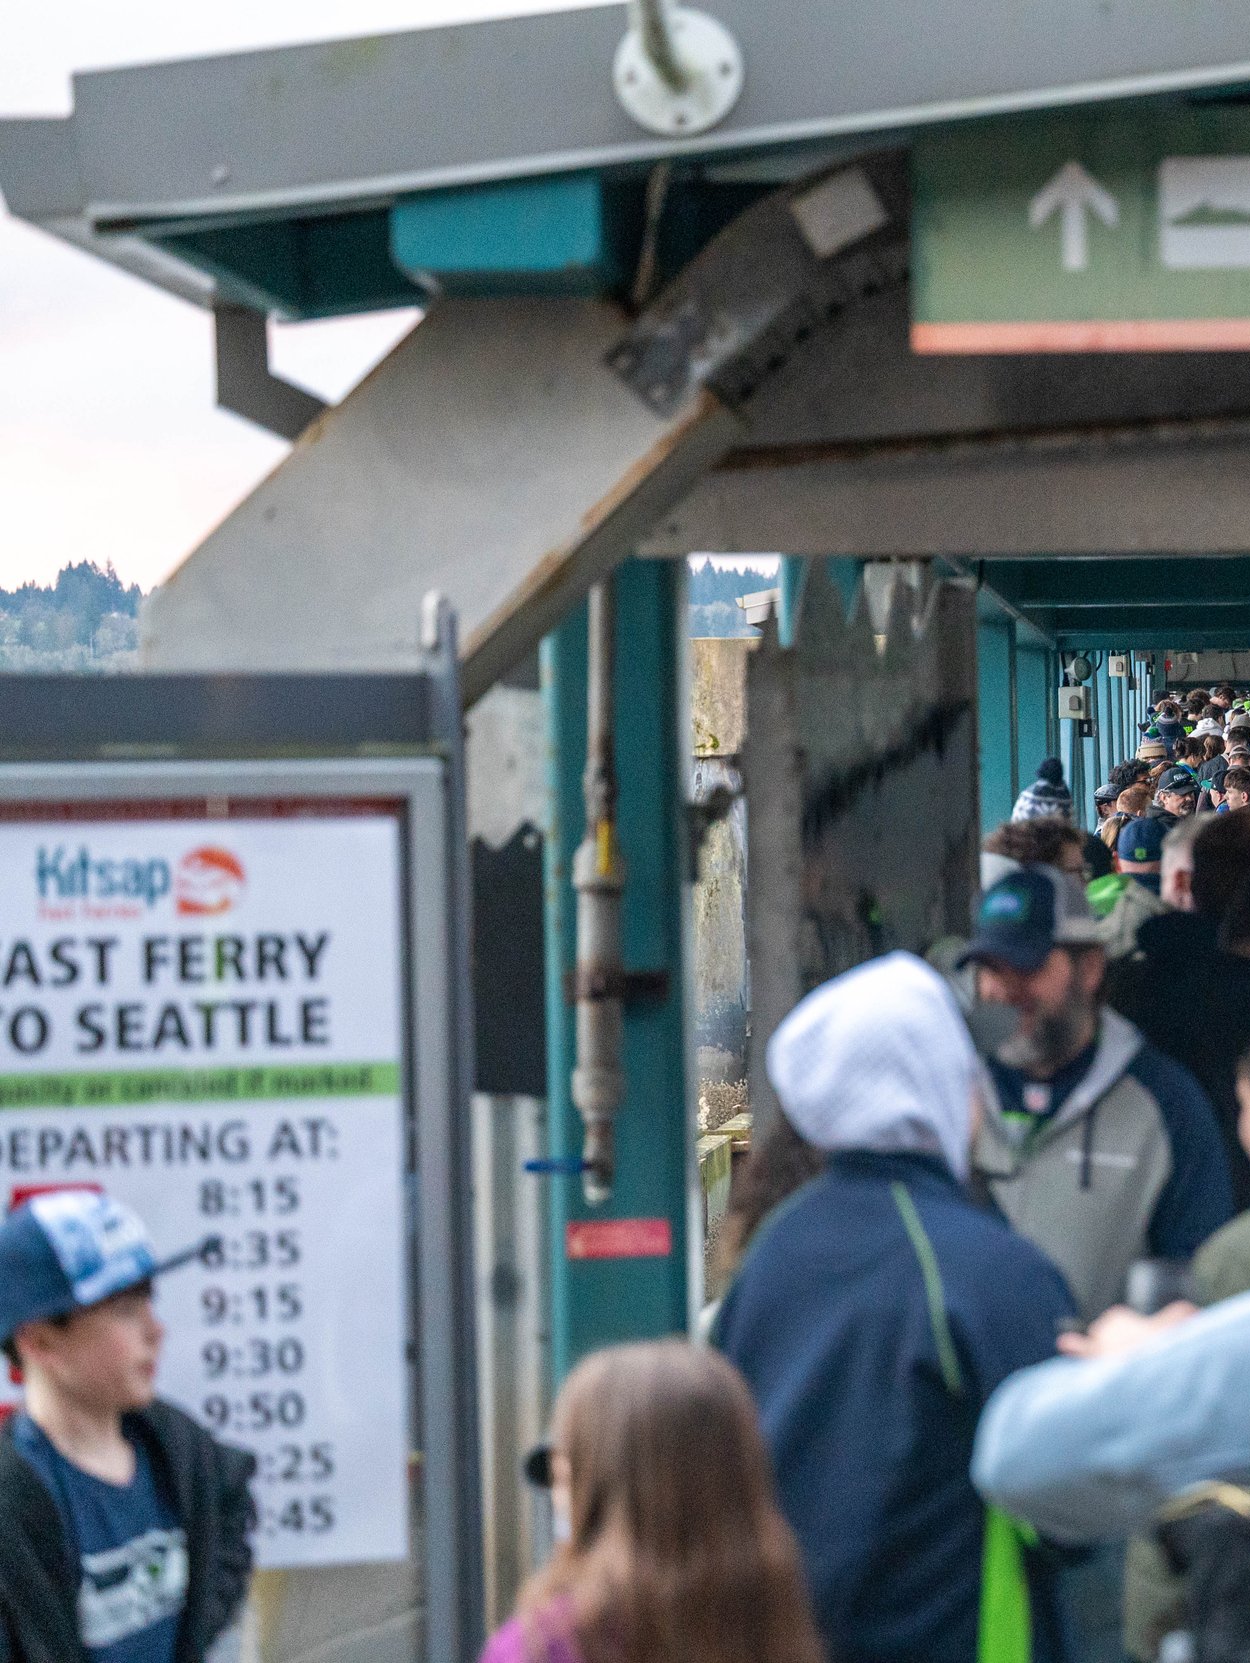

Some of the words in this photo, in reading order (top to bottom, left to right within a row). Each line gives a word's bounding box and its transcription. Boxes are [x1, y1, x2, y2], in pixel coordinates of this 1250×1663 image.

[37, 843, 173, 908] Kitsap
[0, 936, 118, 988] AST
[142, 931, 329, 986] FERRY
[76, 998, 329, 1054] SEATTLE
[0, 1121, 251, 1172] EPARTING
[268, 1118, 340, 1163] AT:
[199, 1178, 301, 1217] 8:15
[201, 1287, 303, 1326] 9:15
[202, 1339, 305, 1378] 9:30
[203, 1391, 306, 1431] 9:50
